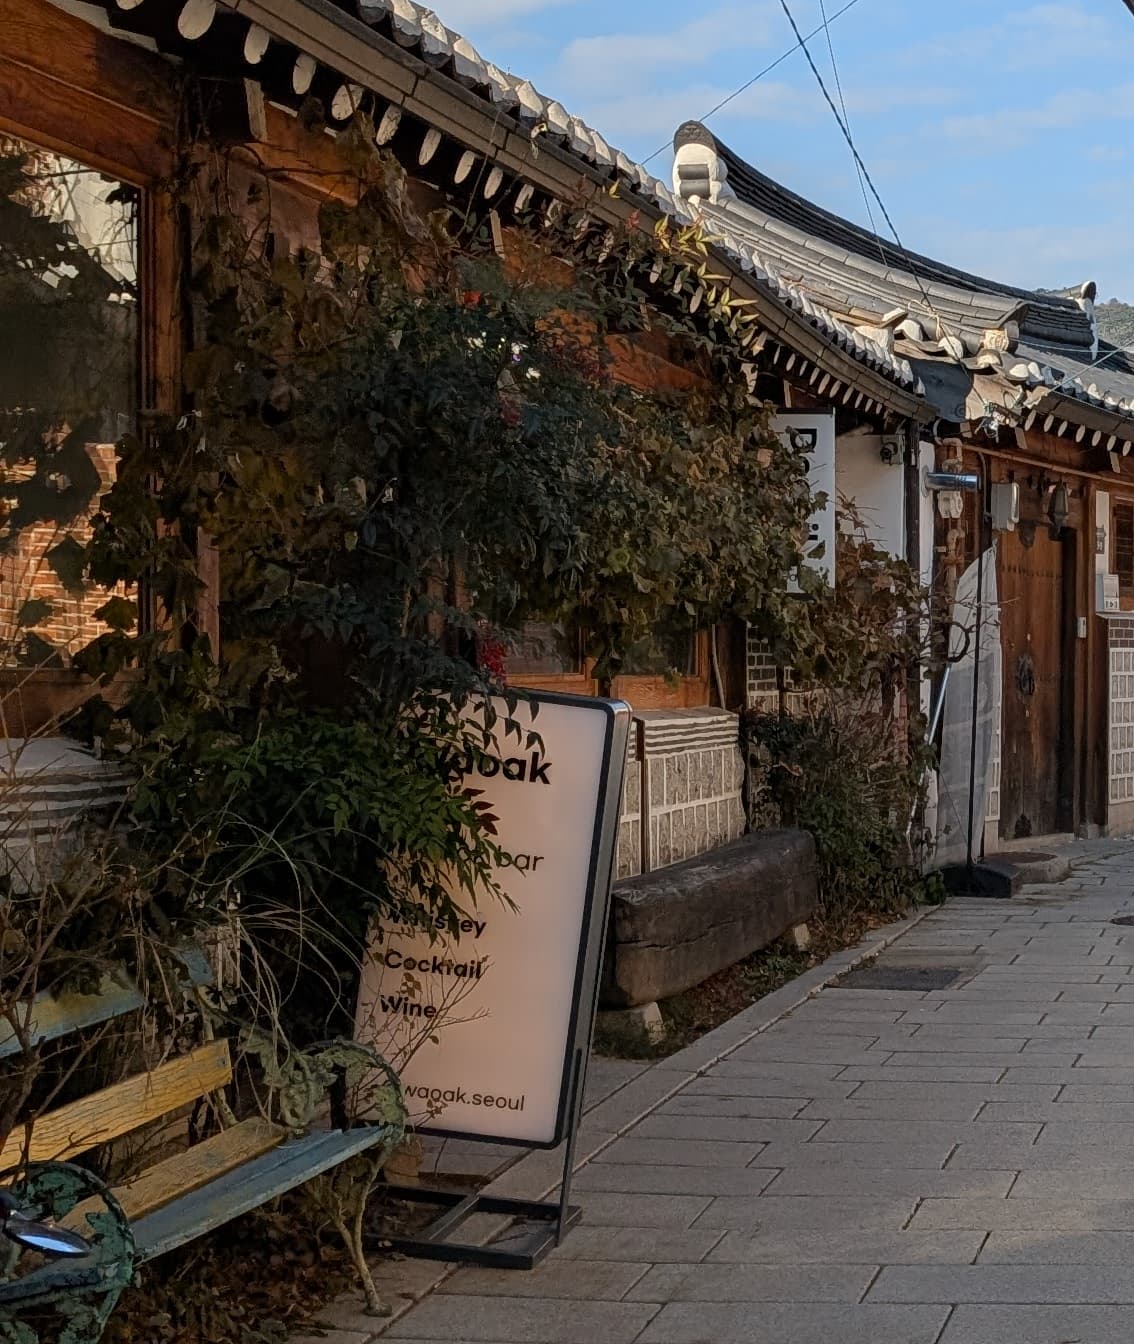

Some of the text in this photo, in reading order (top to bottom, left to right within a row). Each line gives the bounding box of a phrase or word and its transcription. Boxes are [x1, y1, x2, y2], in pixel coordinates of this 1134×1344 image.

[495, 844, 545, 872] bar
[384, 950, 482, 979] Cocktail
[380, 994, 438, 1019] Wine
